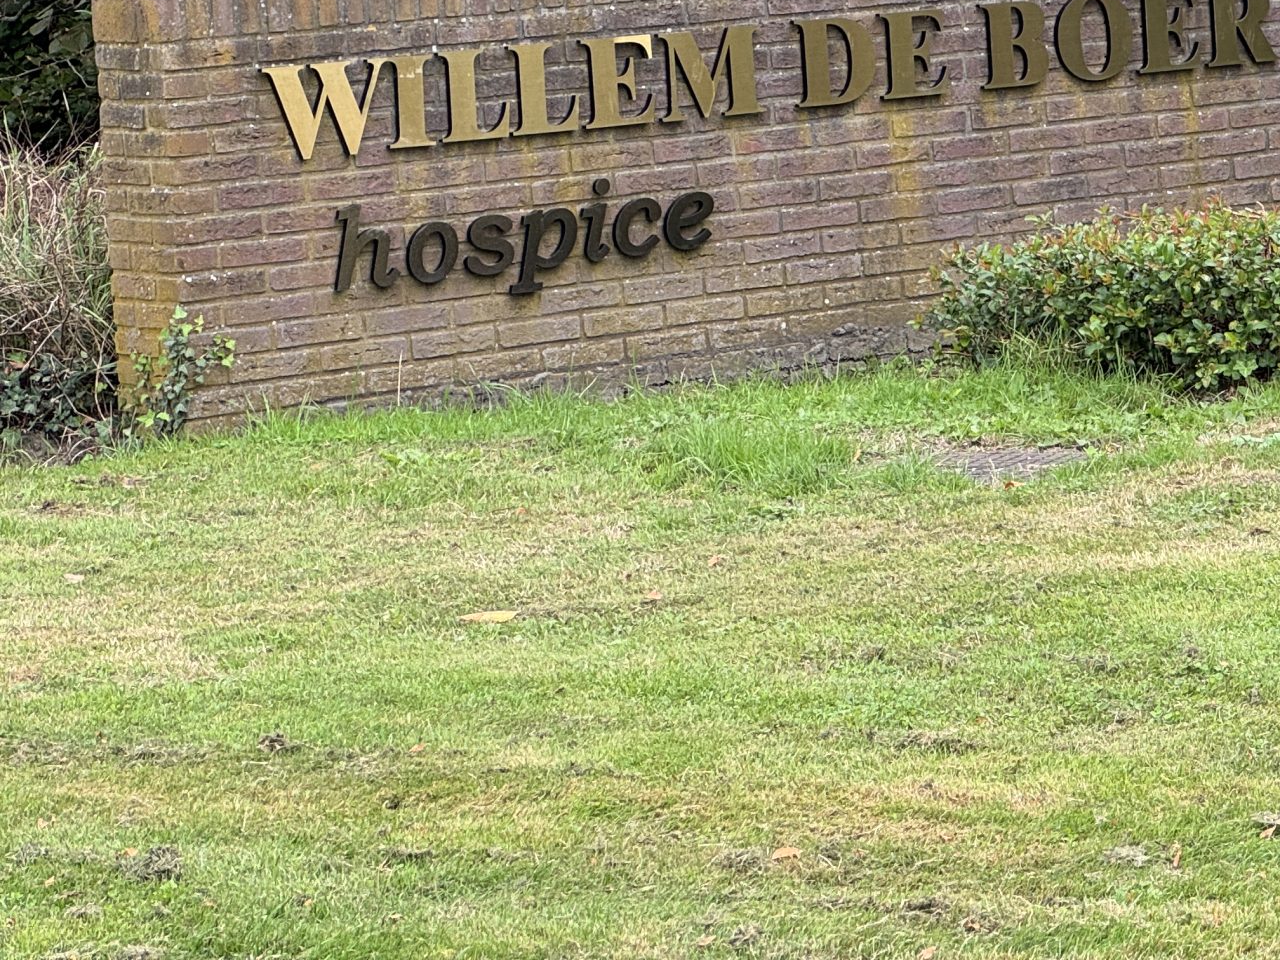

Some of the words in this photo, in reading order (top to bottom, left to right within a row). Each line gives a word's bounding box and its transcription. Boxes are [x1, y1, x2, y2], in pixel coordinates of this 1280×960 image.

[260, 26, 764, 161] WILLEM
[790, 9, 948, 109] DE
[334, 178, 714, 294] hospice
